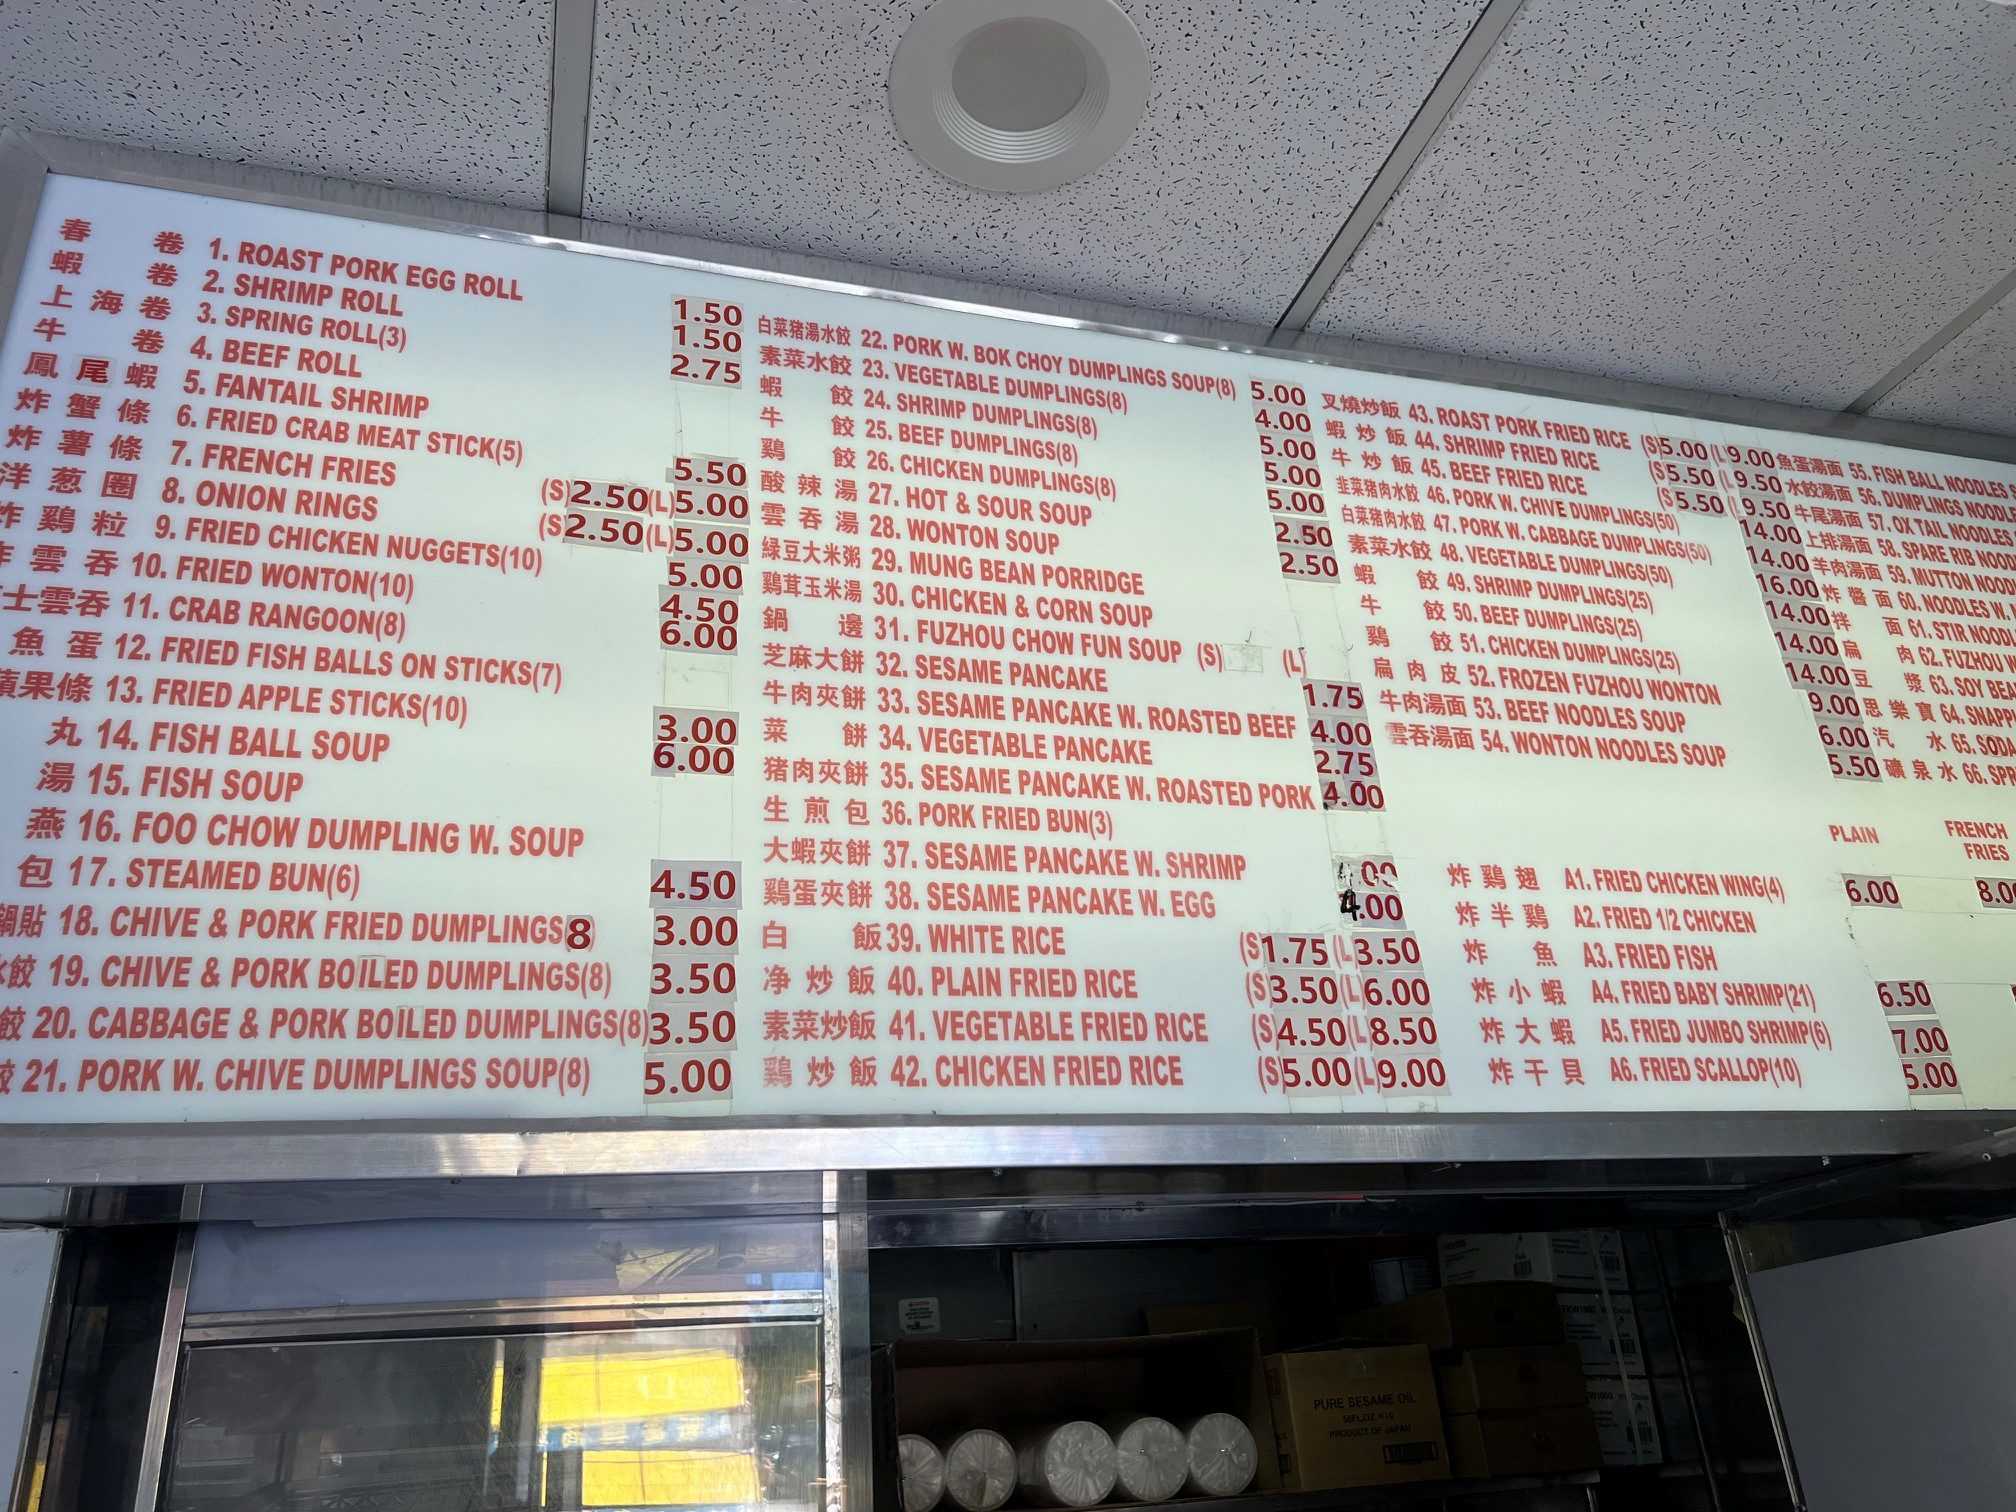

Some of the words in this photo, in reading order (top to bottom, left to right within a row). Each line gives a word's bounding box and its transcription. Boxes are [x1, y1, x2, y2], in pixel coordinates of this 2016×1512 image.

[208, 236, 229, 261] 1.
[237, 241, 323, 272] ROAST
[328, 253, 398, 284] PORK
[405, 264, 457, 291] EGG
[462, 272, 523, 301] ROLL
[674, 297, 742, 326] 1.50
[671, 353, 741, 383] 2.75
[760, 344, 851, 375] 素菜水餃
[860, 327, 888, 350] 22.
[892, 332, 943, 358] PORK
[945, 340, 968, 361] W.
[972, 343, 1011, 367] BOK
[1014, 349, 1063, 374] CHOY
[1068, 357, 1167, 387] DUMPLINGS
[1250, 379, 1306, 406] 5.00
[176, 402, 197, 427] 6.
[205, 406, 278, 436] FRIED
[284, 415, 351, 444] CRAB
[355, 423, 420, 451] MEAT
[1254, 408, 1311, 433] 4.00
[1407, 402, 1435, 425] 43.
[1435, 406, 1491, 430] ROAST
[1493, 413, 1542, 438] PORK
[1542, 420, 1591, 444] FRIED
[1592, 427, 1631, 450] RICE
[675, 457, 747, 486] 5.50
[1847, 460, 1871, 479] 55.
[1870, 464, 1907, 484] FISH
[1906, 469, 1945, 491] BALL
[1943, 475, 2008, 499] NOODLES
[867, 480, 899, 506] 27.
[904, 485, 947, 511] HOT
[955, 491, 971, 515] &
[976, 493, 1034, 522] SOUR
[1038, 500, 1093, 526] SOUP
[1425, 484, 1450, 505] 46.
[1451, 487, 1497, 510] PORK
[1496, 492, 1519, 512] W.
[1519, 494, 1567, 518] CHIVE
[154, 512, 175, 541] 9.
[184, 516, 261, 546] FRIED
[267, 524, 380, 556] CHICKEN
[1275, 520, 1333, 547] 2.50
[1740, 518, 1802, 543] 14.00
[1866, 510, 1891, 531] 57.
[1890, 515, 1915, 535] OX
[1912, 516, 1949, 539] TAIL
[1947, 523, 2014, 547] NOODLES
[1876, 536, 1902, 558] 58.
[1900, 540, 1948, 563] SPARE
[1948, 545, 1977, 567] RIB
[870, 545, 904, 574] 29.
[908, 550, 974, 580] MUNG
[978, 556, 1036, 586] BEAN
[1040, 564, 1144, 595] PORRIDGE
[1445, 572, 1471, 592] 49.
[1472, 573, 1533, 598] SHRIMP
[1756, 572, 1820, 598] 16.00
[660, 594, 739, 625] 4.50
[1896, 590, 1922, 611] 60.
[1921, 593, 1991, 619] NOODLES
[1988, 600, 2009, 620] W.
[114, 632, 151, 661] 12.
[160, 635, 240, 666] FRIED
[246, 640, 307, 670] FISH
[313, 645, 394, 677] BALLS
[400, 651, 437, 680] ON
[1302, 682, 1363, 710] 1.75
[1466, 662, 1497, 688] 52.
[1497, 665, 1570, 693] FROZEN
[1571, 672, 1645, 699] FUZHOU
[1645, 678, 1722, 705] WONTON
[876, 685, 911, 715] 33.
[916, 689, 1005, 721] SESAME
[1011, 696, 1112, 727] PANCAKE
[1116, 703, 1144, 730] W.
[1147, 705, 1242, 736] ROASTED
[1245, 711, 1296, 740] BEEF
[1808, 690, 1860, 716] 9.00
[657, 713, 737, 744] 3.00
[1314, 748, 1375, 777] 2.75
[1479, 727, 1511, 754] 54.
[1511, 730, 1594, 758] WONTON
[1594, 736, 1679, 764] NOODLES
[1679, 742, 1727, 768] SOUP
[1827, 753, 1880, 777] 5.50
[78, 808, 120, 842] 16.
[132, 810, 197, 845] FOO
[206, 813, 300, 848] CHOW
[306, 817, 459, 853] DUMPLING
[468, 823, 499, 855] W.
[508, 824, 584, 858] SOUP
[1829, 825, 1880, 843] PLAIN
[1945, 820, 2009, 839] FRENCH
[881, 838, 918, 869] 37.
[924, 840, 1017, 872] SESAME
[1023, 845, 1129, 876] PANCAKE
[1132, 849, 1161, 878] W.
[1165, 851, 1247, 880] SHRIMP
[1964, 842, 2010, 861] FRIES
[650, 868, 736, 901] 4.50
[1563, 866, 1592, 891] A1.
[1592, 867, 1644, 893] FRIED
[1644, 871, 1720, 896] CHICKEN
[1844, 879, 1899, 904] 6.00
[1572, 903, 1602, 929] A2.
[1601, 905, 1653, 931] FRIED
[1682, 908, 1757, 933] CHICKEN
[651, 961, 735, 995] 3.50
[1362, 976, 1430, 1006] 6.00
[1878, 981, 1931, 1007] 6.50
[887, 1009, 926, 1041] 41.
[932, 1009, 1073, 1042] VEGETABLE
[1080, 1010, 1148, 1042] FRIED
[1154, 1011, 1209, 1043] RICE
[1600, 1017, 1629, 1043] A5.
[1629, 1017, 1682, 1044] FRIED
[1686, 1018, 1745, 1044] JUMBO
[22, 1058, 66, 1093] 21.
[77, 1057, 163, 1092] PORK
[172, 1058, 203, 1091] W.
[215, 1057, 306, 1091] CHIVE
[313, 1057, 476, 1090] DUMPLINGS
[644, 1058, 731, 1094] 5.00
[1902, 1061, 1958, 1090] 5.00
[1313, 1398, 1344, 1409] PURE
[1347, 1394, 1395, 1407] SESAME
[1397, 1392, 1416, 1403] OIL
[1329, 1428, 1368, 1438] PRODUCT
[1371, 1426, 1382, 1435] OF
[1385, 1424, 1412, 1434] JAPAN
